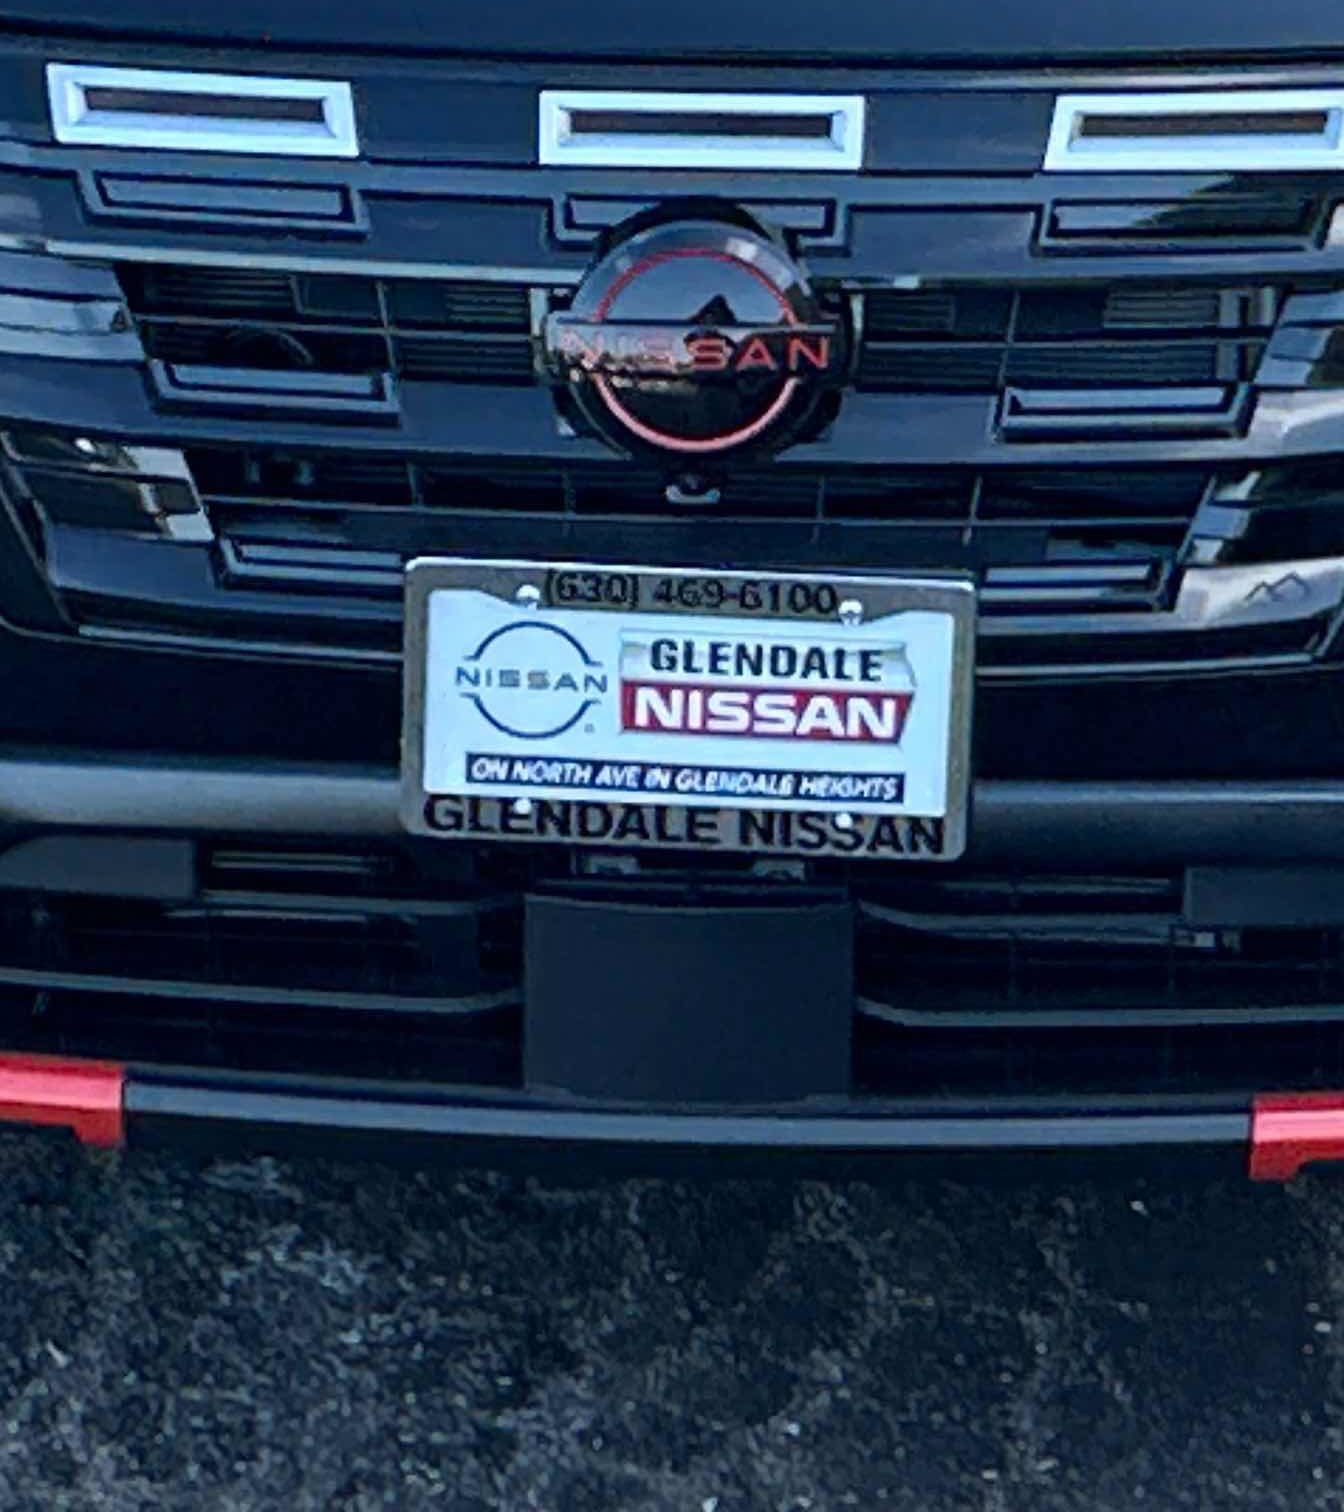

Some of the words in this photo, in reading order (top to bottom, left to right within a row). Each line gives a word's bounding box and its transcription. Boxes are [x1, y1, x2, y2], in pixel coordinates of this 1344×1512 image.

[655, 577, 838, 614] 469-6100
[456, 666, 607, 693] NISSAN
[650, 638, 884, 682] GLENDALE
[634, 690, 896, 738] NISSAN
[471, 757, 509, 781] ON
[511, 759, 593, 785] NORTH
[595, 764, 642, 788] AVE
[644, 766, 672, 790] IN
[674, 768, 796, 796] GLENDALE
[798, 774, 899, 801] HEIGHTS
[423, 794, 720, 846] GLENDALE
[739, 809, 945, 855] NISSAN
